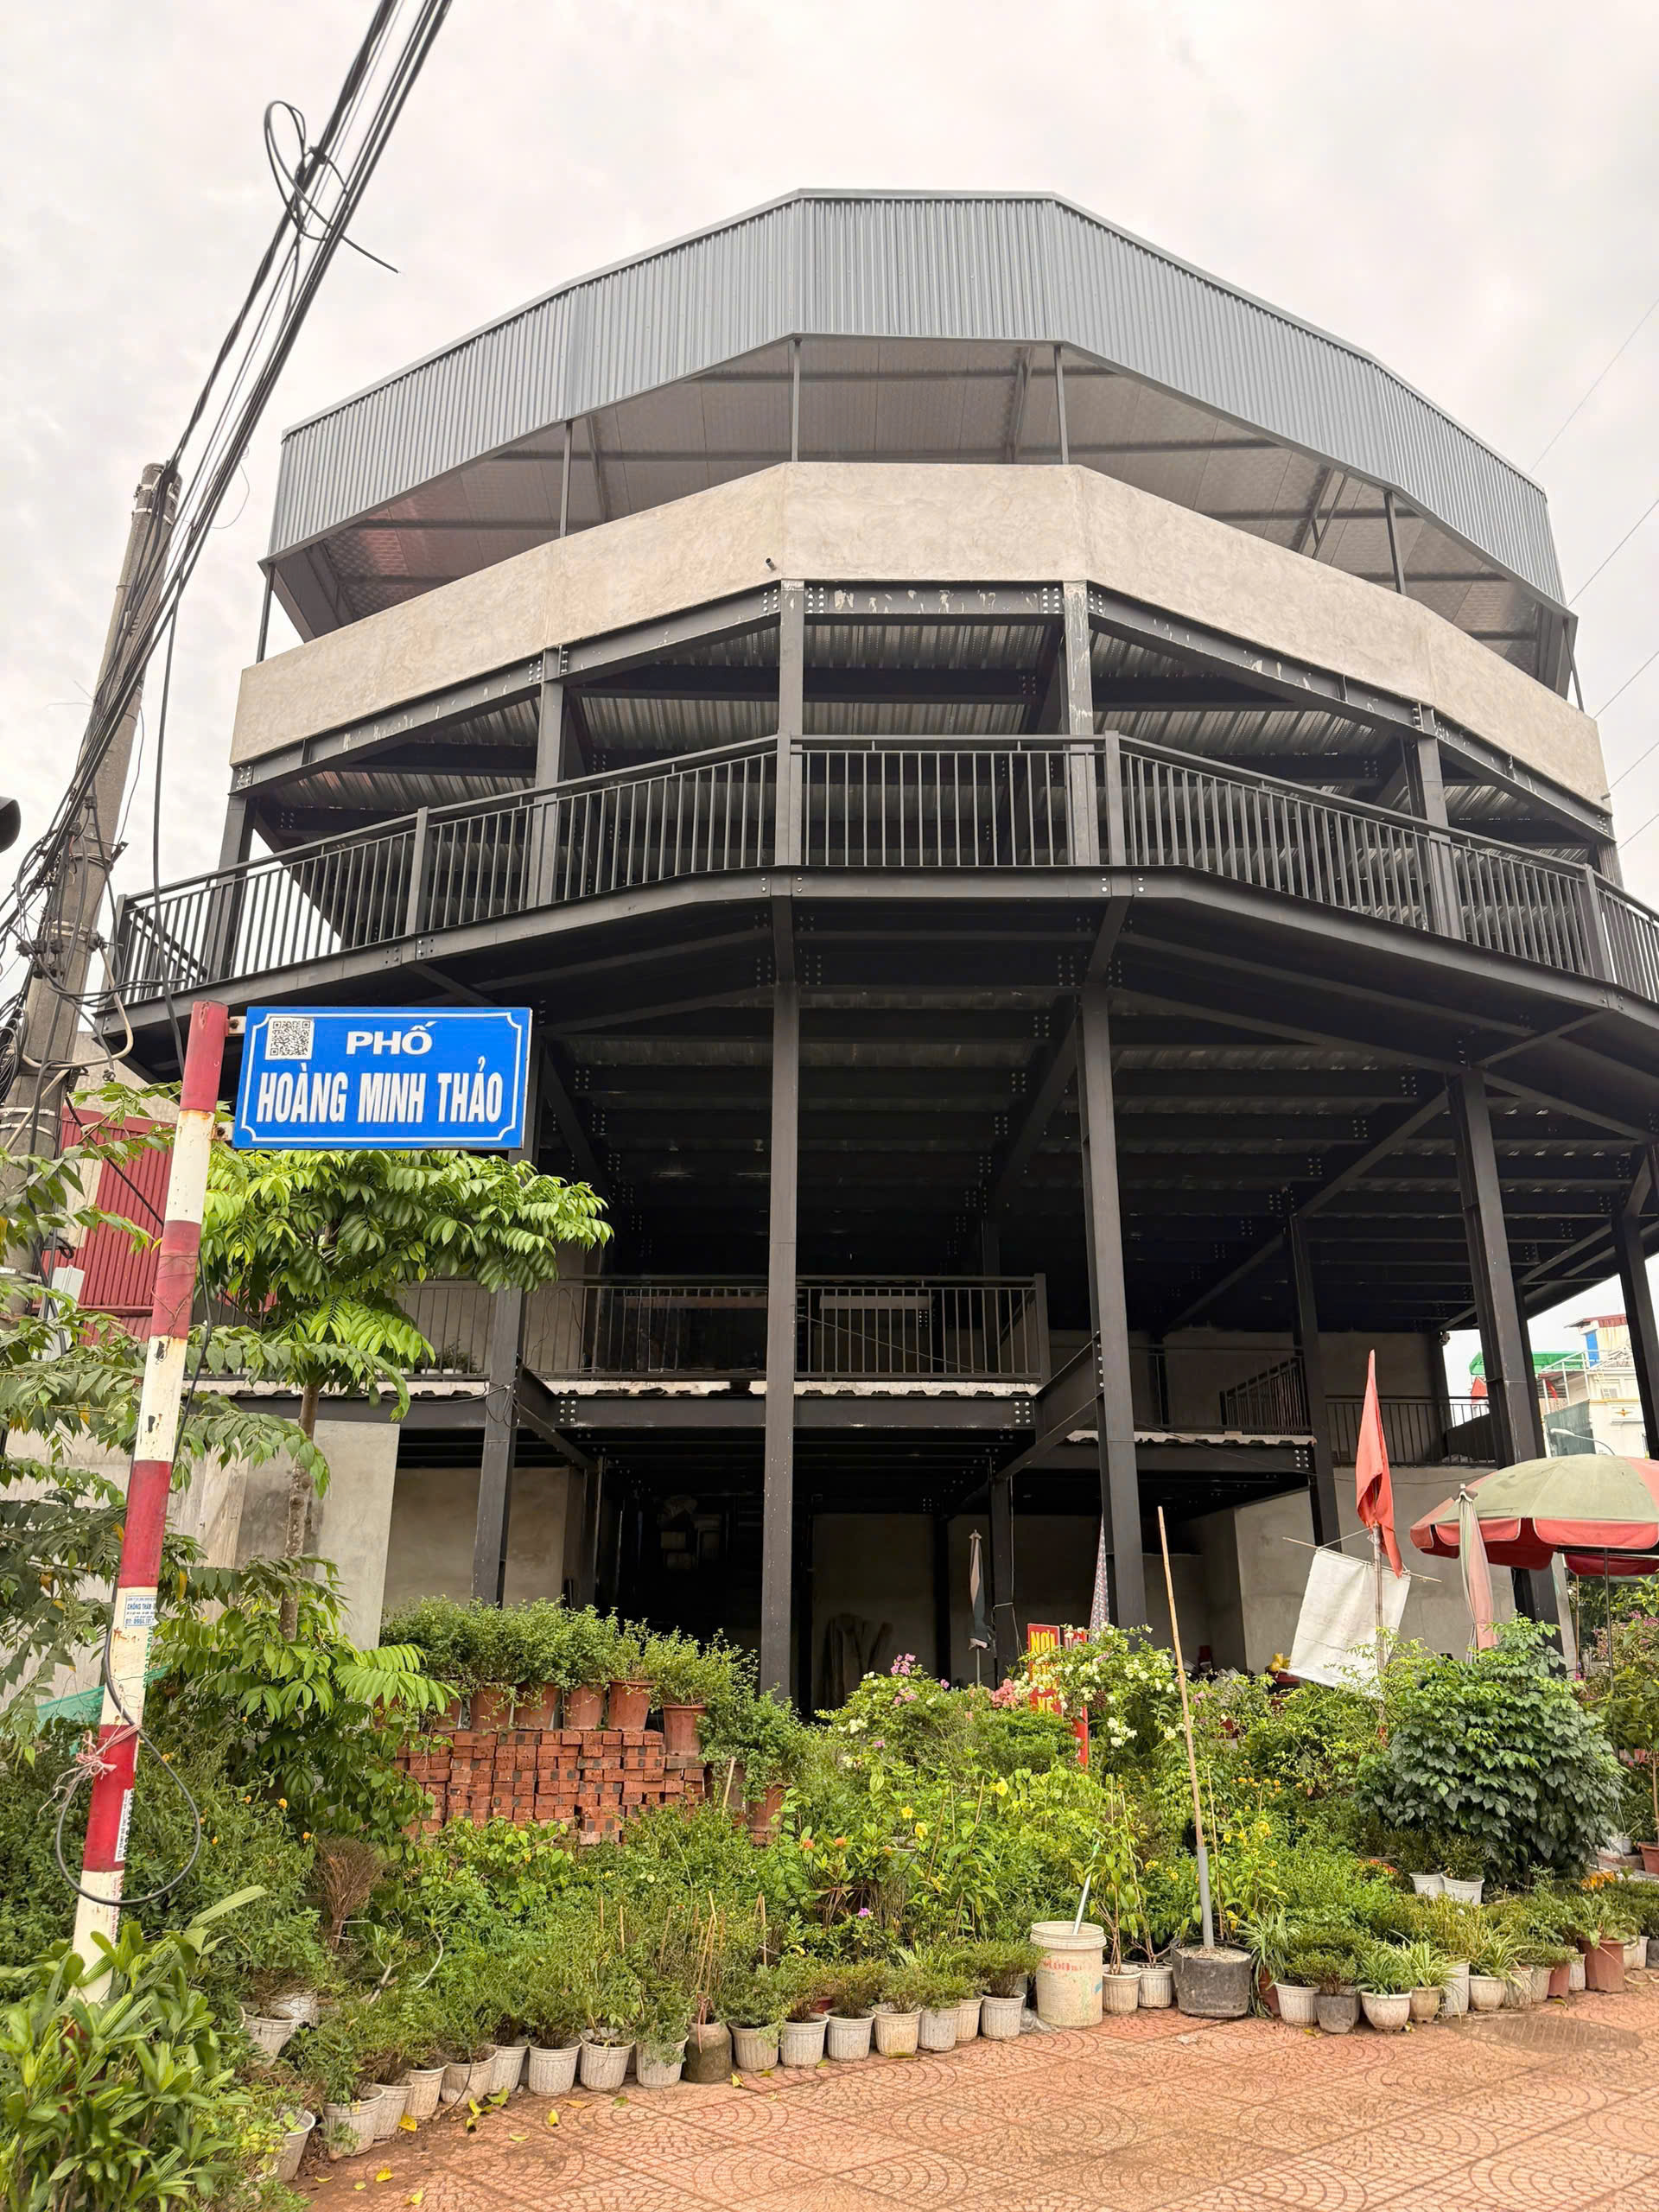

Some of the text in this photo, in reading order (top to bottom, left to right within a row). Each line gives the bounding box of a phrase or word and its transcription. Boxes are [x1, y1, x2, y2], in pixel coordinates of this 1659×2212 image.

[346, 1020, 438, 1056] PHỐ
[256, 1055, 504, 1123] HOÀNG MINH THẢO
